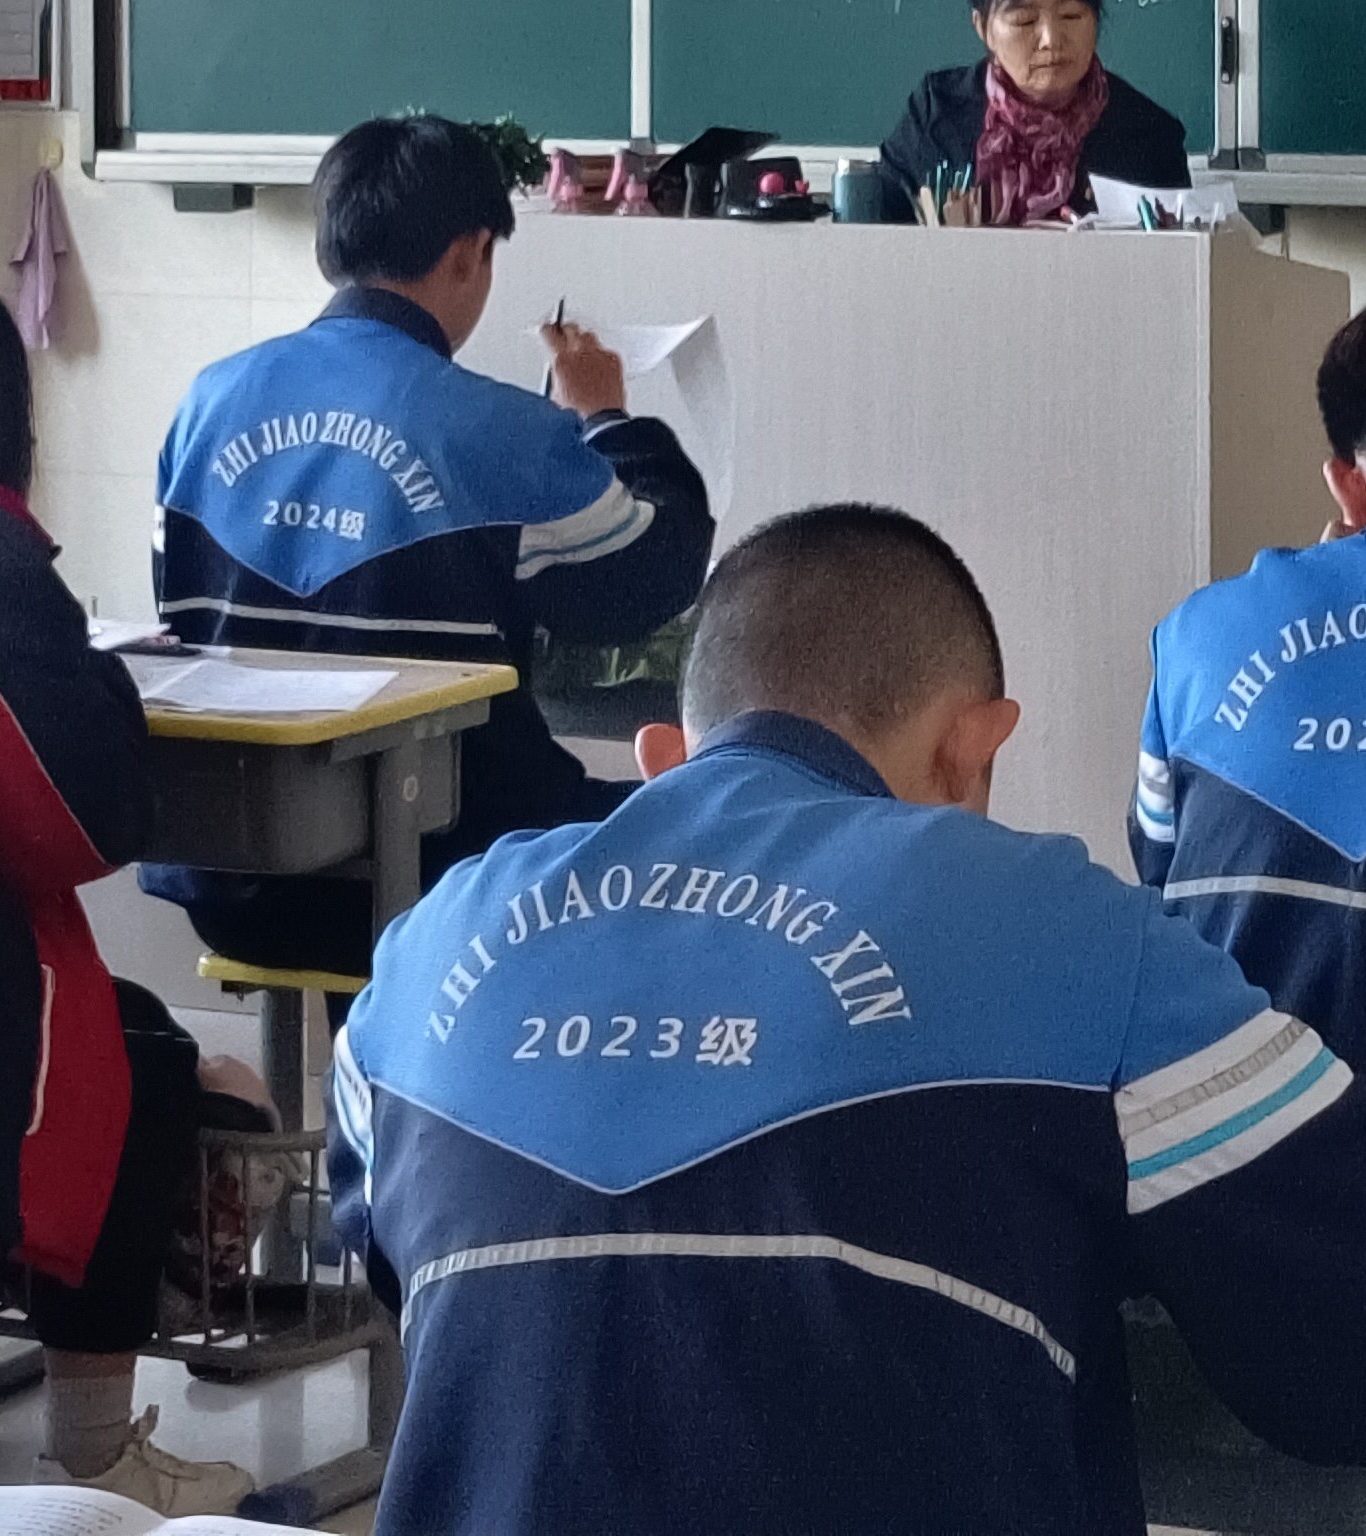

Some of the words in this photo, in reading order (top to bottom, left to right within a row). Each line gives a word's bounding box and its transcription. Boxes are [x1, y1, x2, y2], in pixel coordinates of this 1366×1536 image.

[211, 431, 259, 488] ZHI
[392, 462, 445, 515] XIN
[262, 500, 367, 541] 2024级
[1214, 650, 1277, 733] ZHI
[424, 936, 499, 1046] ZHI
[810, 928, 913, 1028] XIN
[511, 1013, 759, 1066] 2023级
